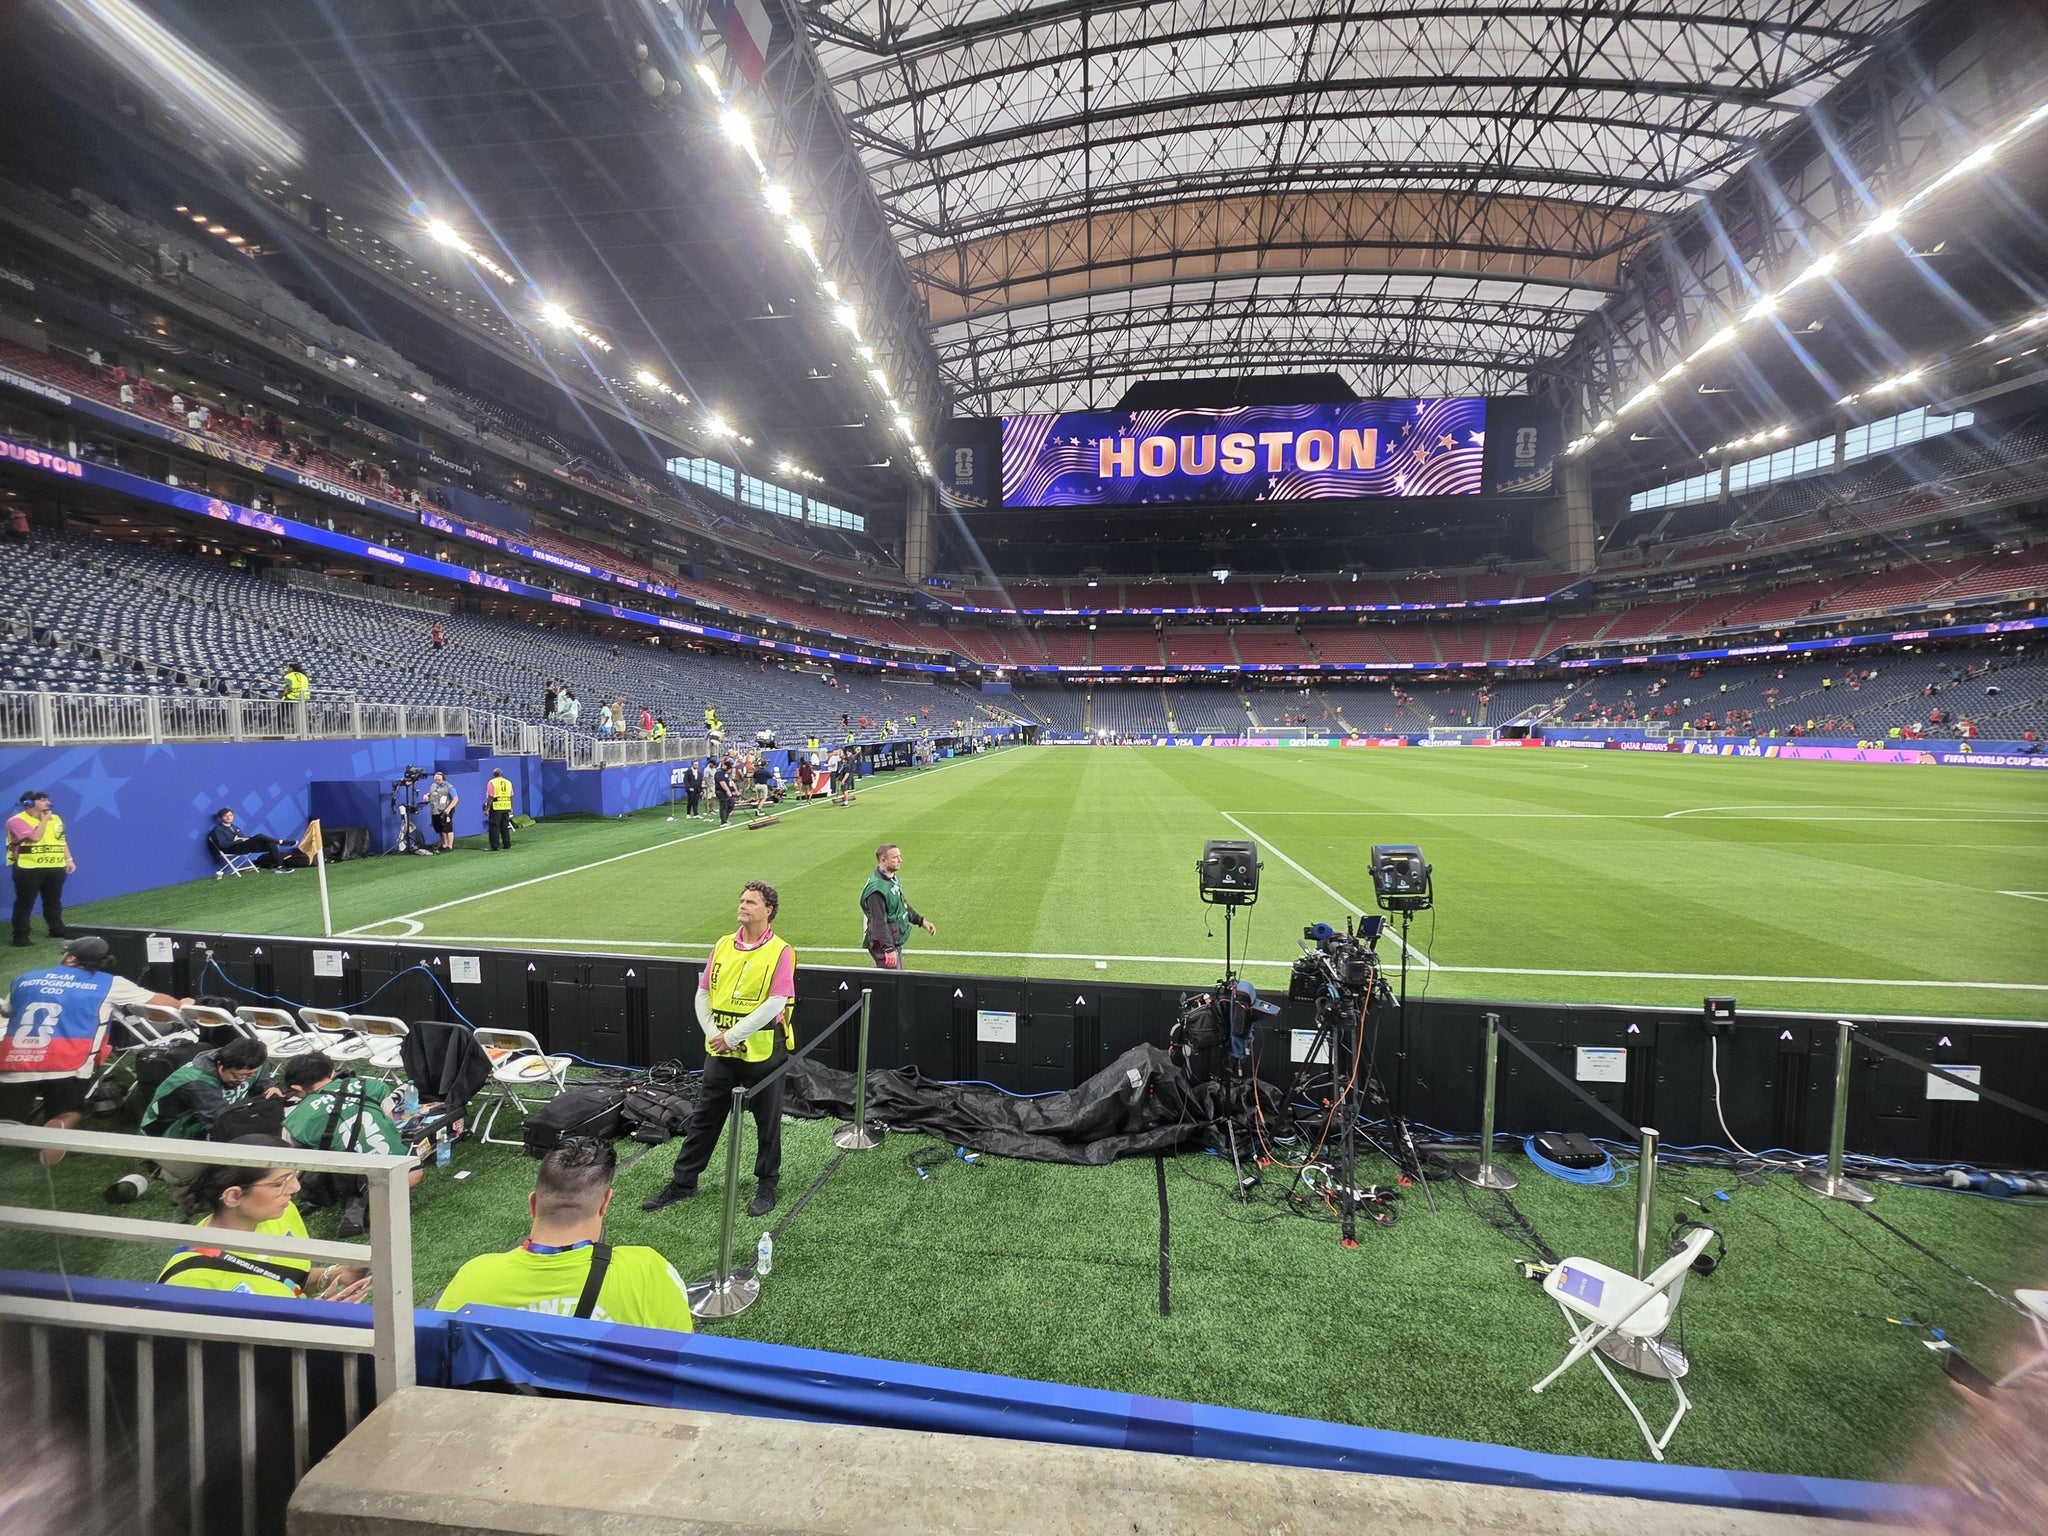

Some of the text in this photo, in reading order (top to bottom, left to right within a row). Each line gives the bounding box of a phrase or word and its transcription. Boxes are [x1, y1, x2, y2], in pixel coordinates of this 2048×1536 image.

[1099, 428, 1378, 478] HOUSTON
[429, 453, 472, 476] HOUSTON
[298, 475, 366, 506] HOUSTON
[465, 527, 498, 546] HOUSTON
[1777, 564, 1813, 574] HOUSTON
[1759, 620, 1796, 629] HOUSTON
[1174, 738, 1194, 746] VISA
[1289, 738, 1329, 747] aramco
[1492, 738, 1523, 747] Lenovo
[1620, 741, 1668, 752] QATAR AIRWAYS
[1698, 743, 1719, 755] VISA
[1738, 745, 1761, 757] VISA
[1943, 754, 1966, 764] FIFA
[1966, 755, 2005, 765] WORLD
[2006, 756, 2030, 766] CUP
[45, 973, 75, 982] TEAM
[40, 986, 64, 995] COD
[5, 1055, 45, 1063] 2026
[223, 1253, 237, 1264] FIFA
